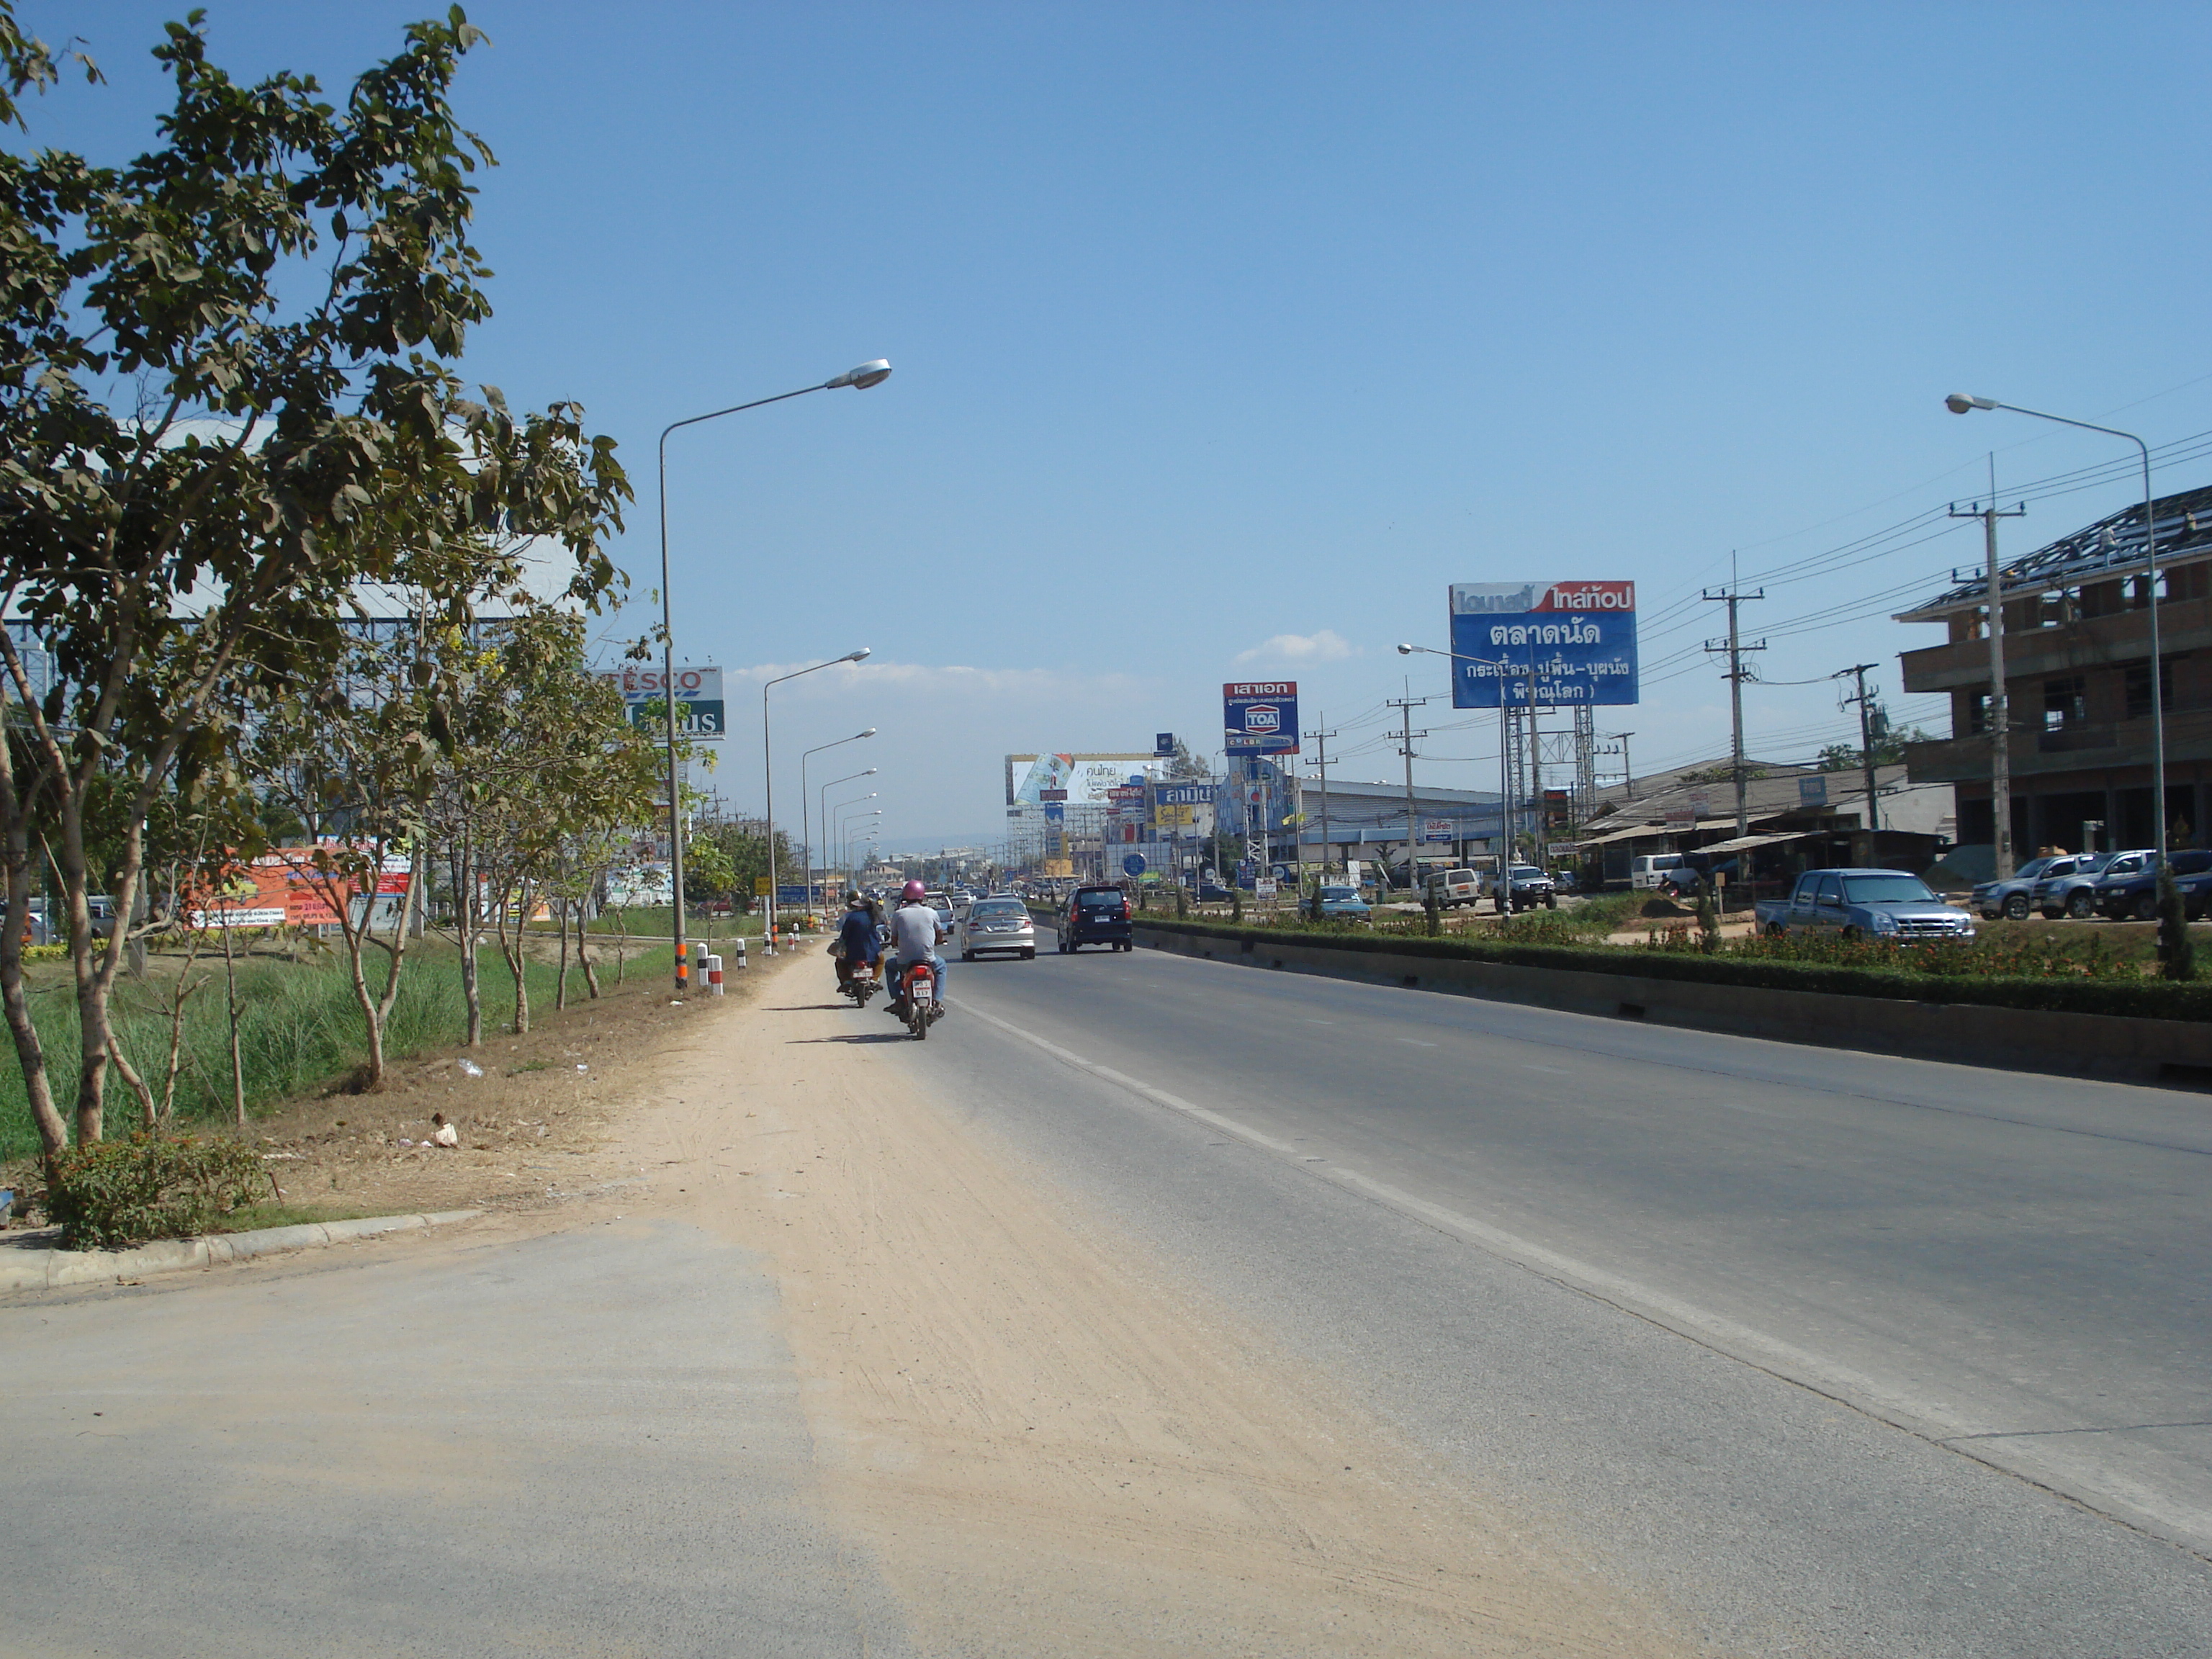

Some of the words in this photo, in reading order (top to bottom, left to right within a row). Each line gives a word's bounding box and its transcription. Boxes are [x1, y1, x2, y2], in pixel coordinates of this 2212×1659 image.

[1550, 585, 1632, 609] ไทล์ท้อป
[1490, 616, 1601, 646] ตลาดนัด
[1233, 683, 1288, 695] เสาเอก
[1248, 714, 1277, 725] TOA
[1087, 764, 1116, 777] คนไทย
